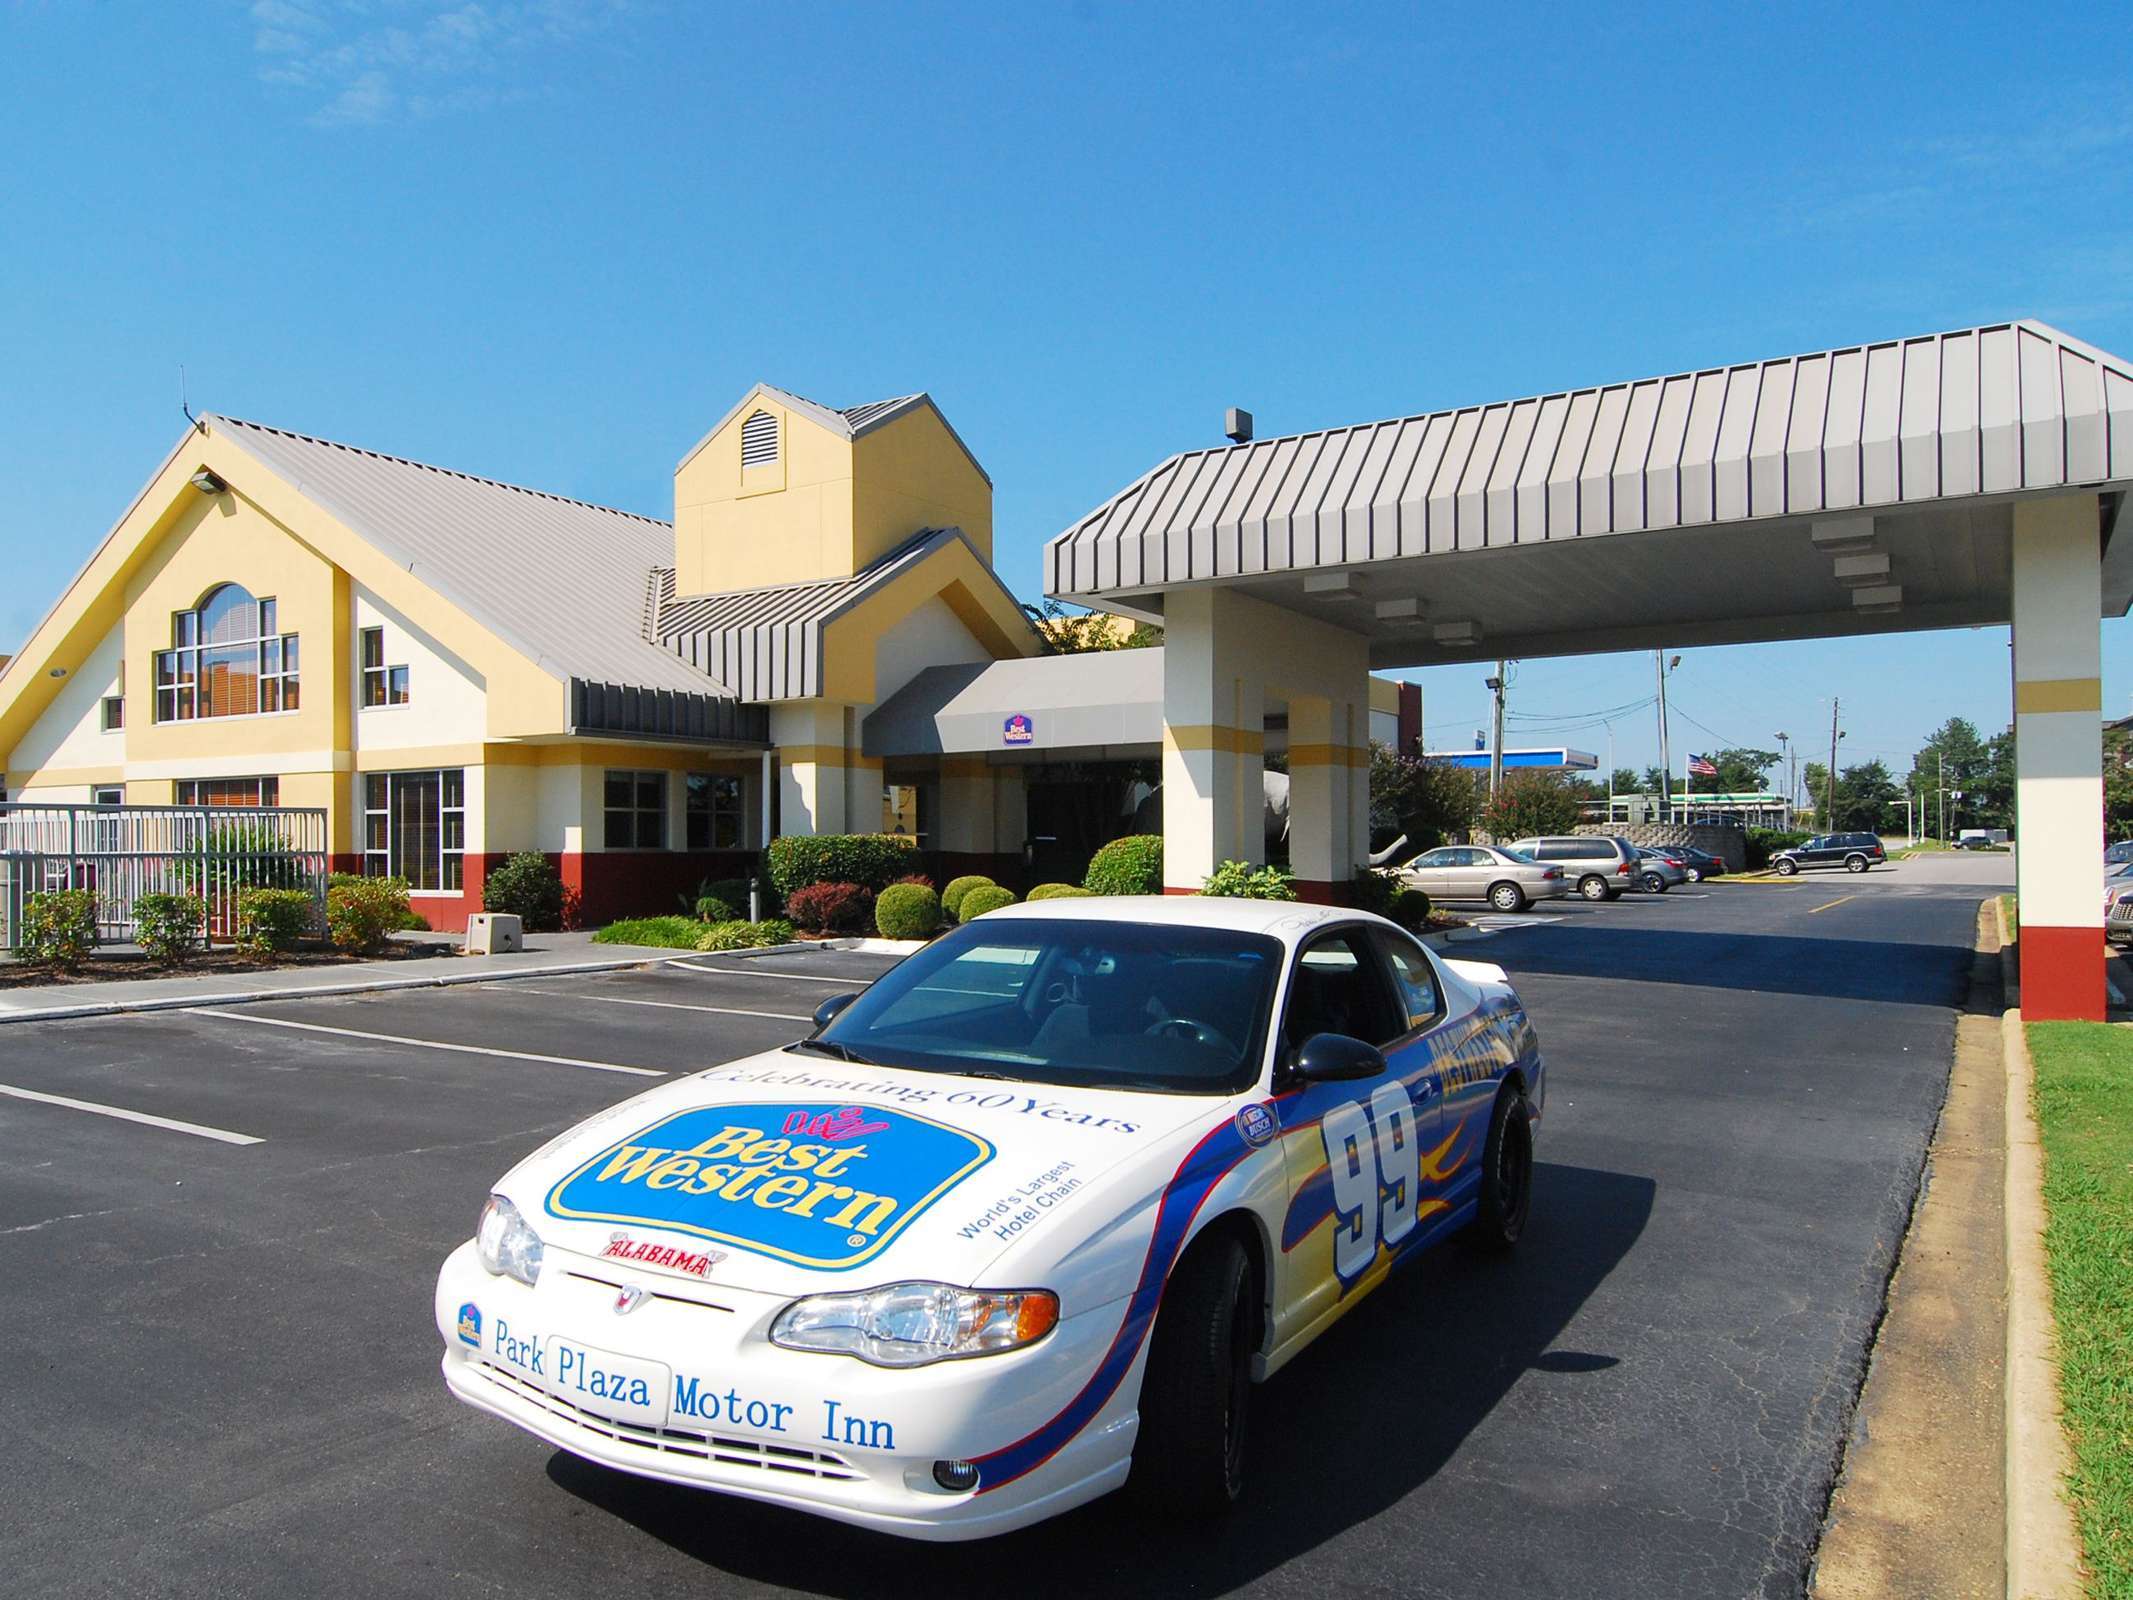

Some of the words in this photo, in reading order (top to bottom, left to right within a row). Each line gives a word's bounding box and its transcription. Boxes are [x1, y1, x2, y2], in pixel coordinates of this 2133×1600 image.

[699, 1069, 944, 1102] Celebrating
[946, 1090, 1015, 1108] 60
[1013, 1098, 1142, 1135] Years
[684, 1126, 871, 1178] Best
[1323, 1079, 1419, 1279] 99
[595, 1144, 899, 1236] Western
[956, 1195, 1022, 1239] World's
[1016, 1160, 1076, 1196] Largest
[993, 1205, 1041, 1241] Hotel
[1036, 1178, 1083, 1208] Chain
[606, 1239, 710, 1276] ALABAMA
[495, 1319, 545, 1376] Park
[559, 1346, 651, 1406] Plaza
[674, 1374, 794, 1432] Motor
[821, 1400, 896, 1450] Inn
